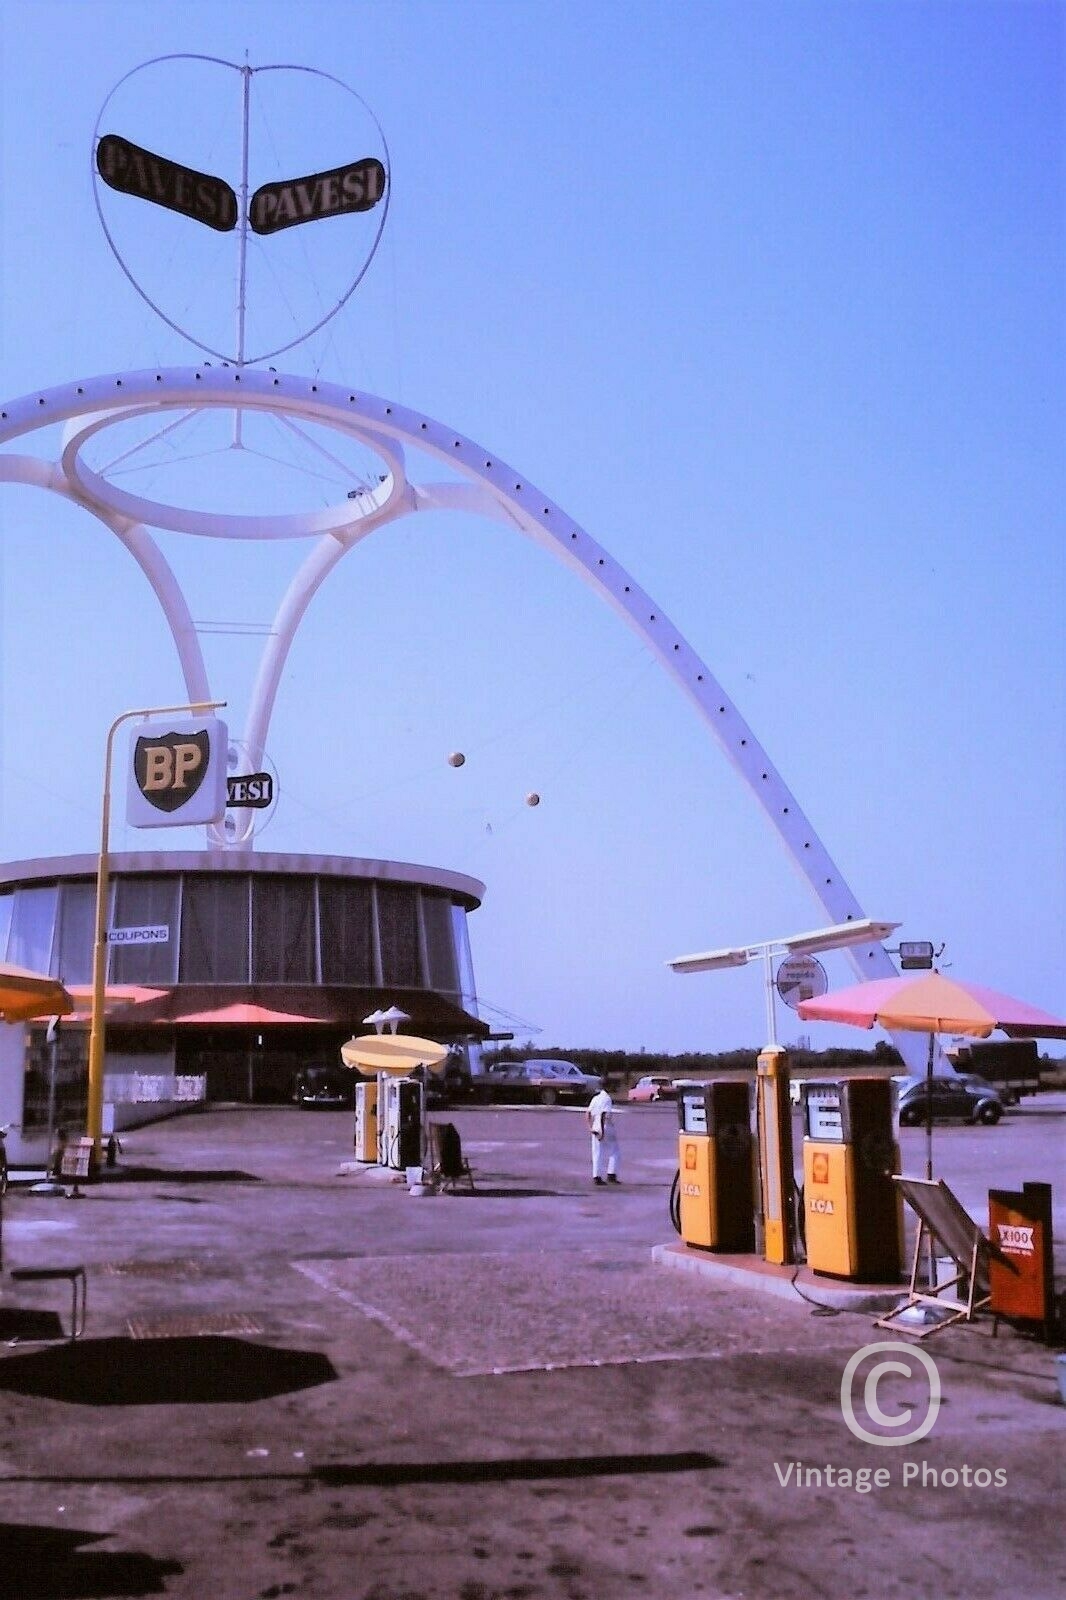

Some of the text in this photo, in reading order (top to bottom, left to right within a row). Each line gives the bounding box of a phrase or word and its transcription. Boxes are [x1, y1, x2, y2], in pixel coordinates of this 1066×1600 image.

[254, 164, 380, 227] PAVESI
[143, 743, 202, 791] BP
[109, 929, 167, 941] COUPONS
